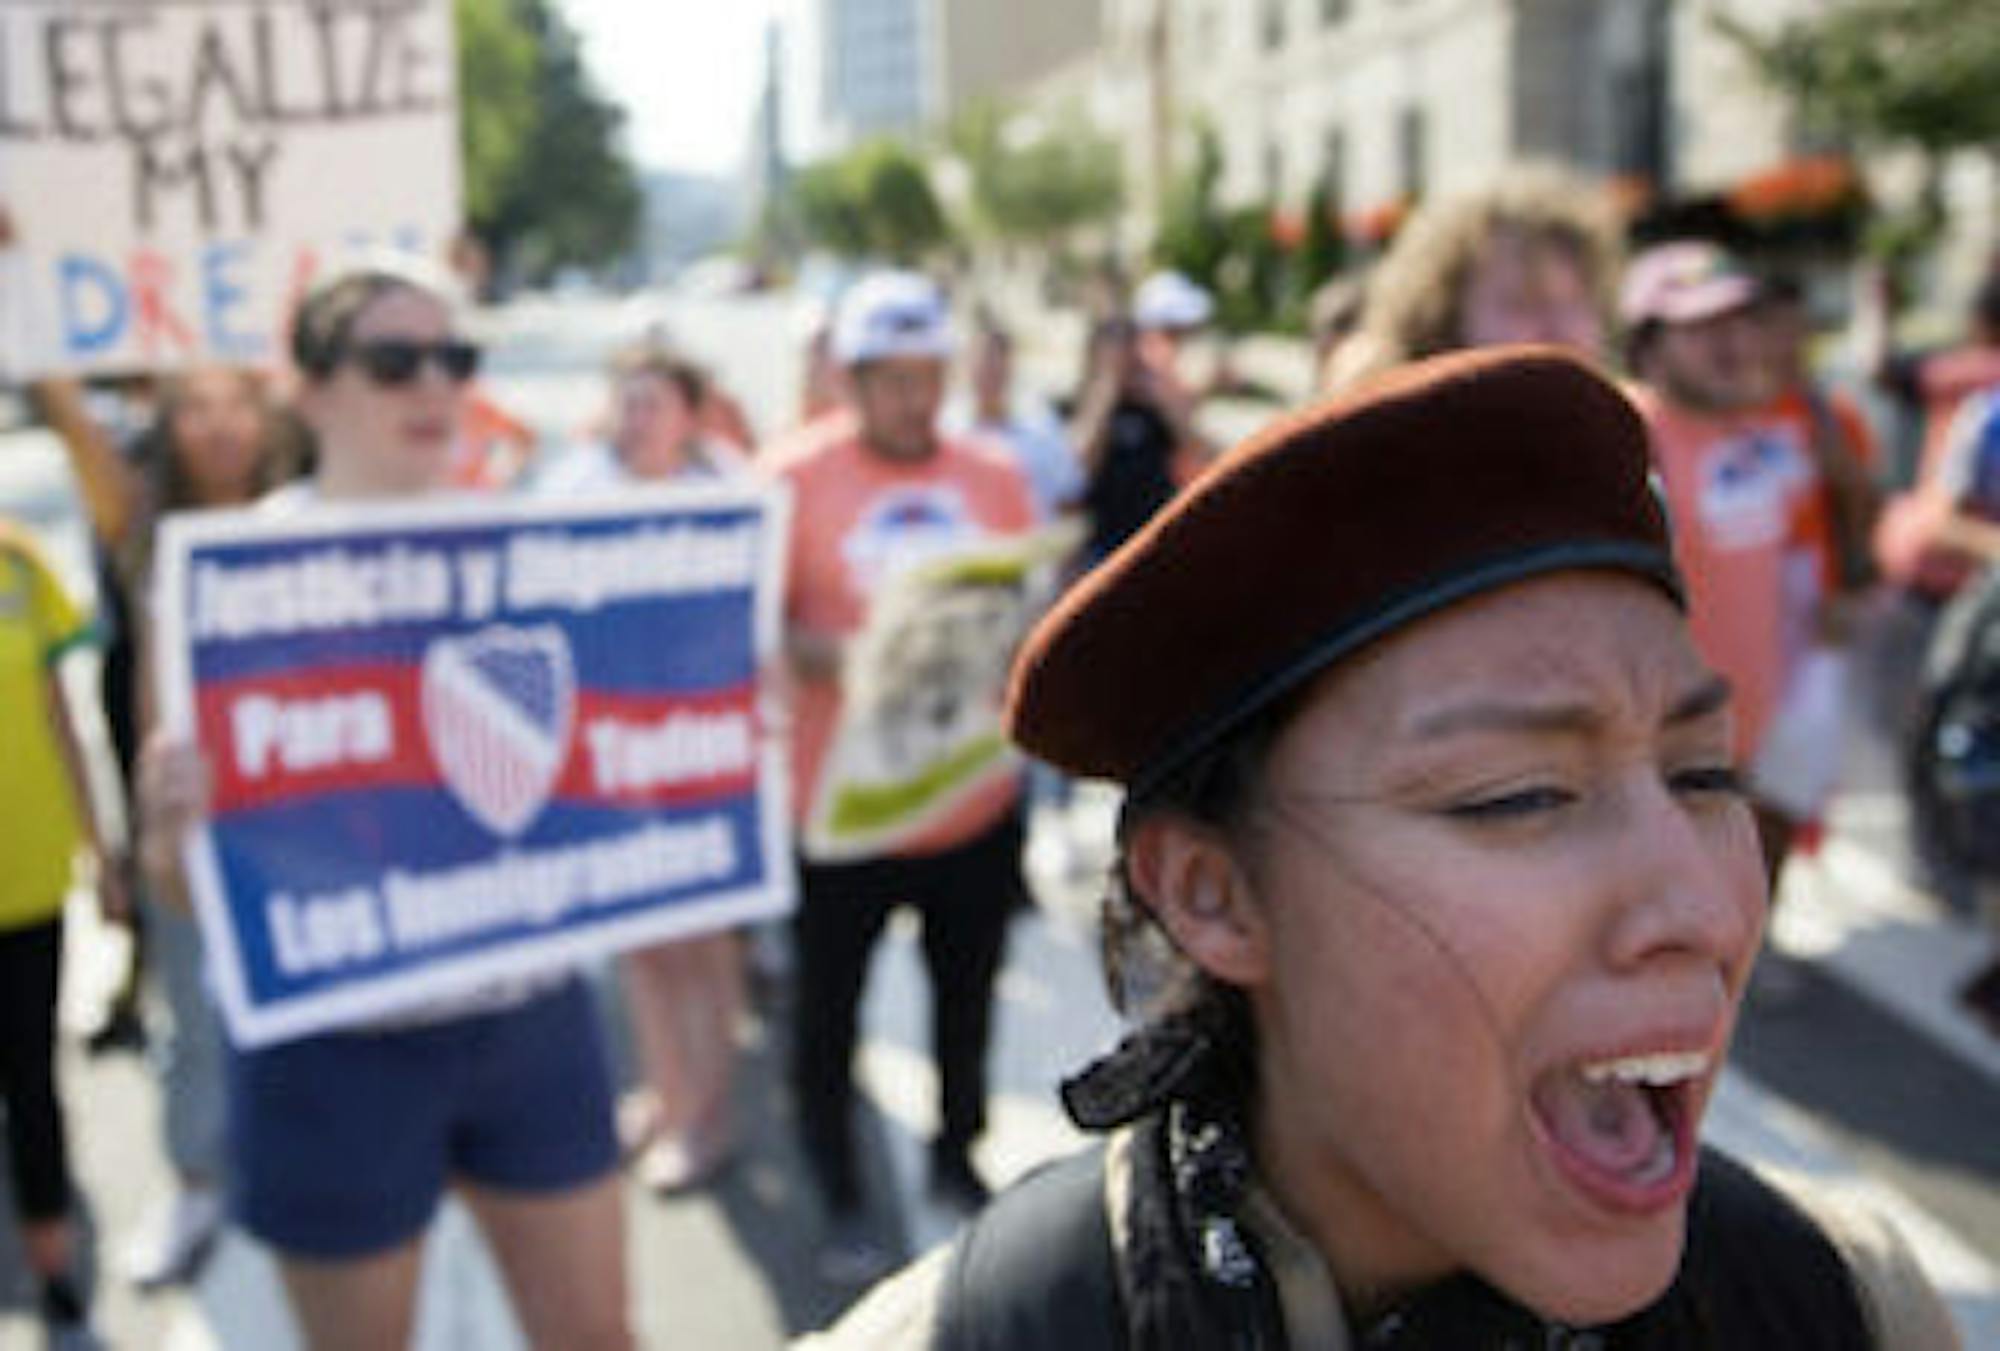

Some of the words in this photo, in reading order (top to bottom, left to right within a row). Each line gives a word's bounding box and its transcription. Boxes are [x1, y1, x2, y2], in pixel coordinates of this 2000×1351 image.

[0, 6, 440, 142] LEGALIZE
[133, 138, 278, 230] MY
[195, 547, 450, 638] Justicia
[232, 694, 392, 778] Para
[588, 710, 752, 790] Todos
[268, 888, 386, 976] Los
